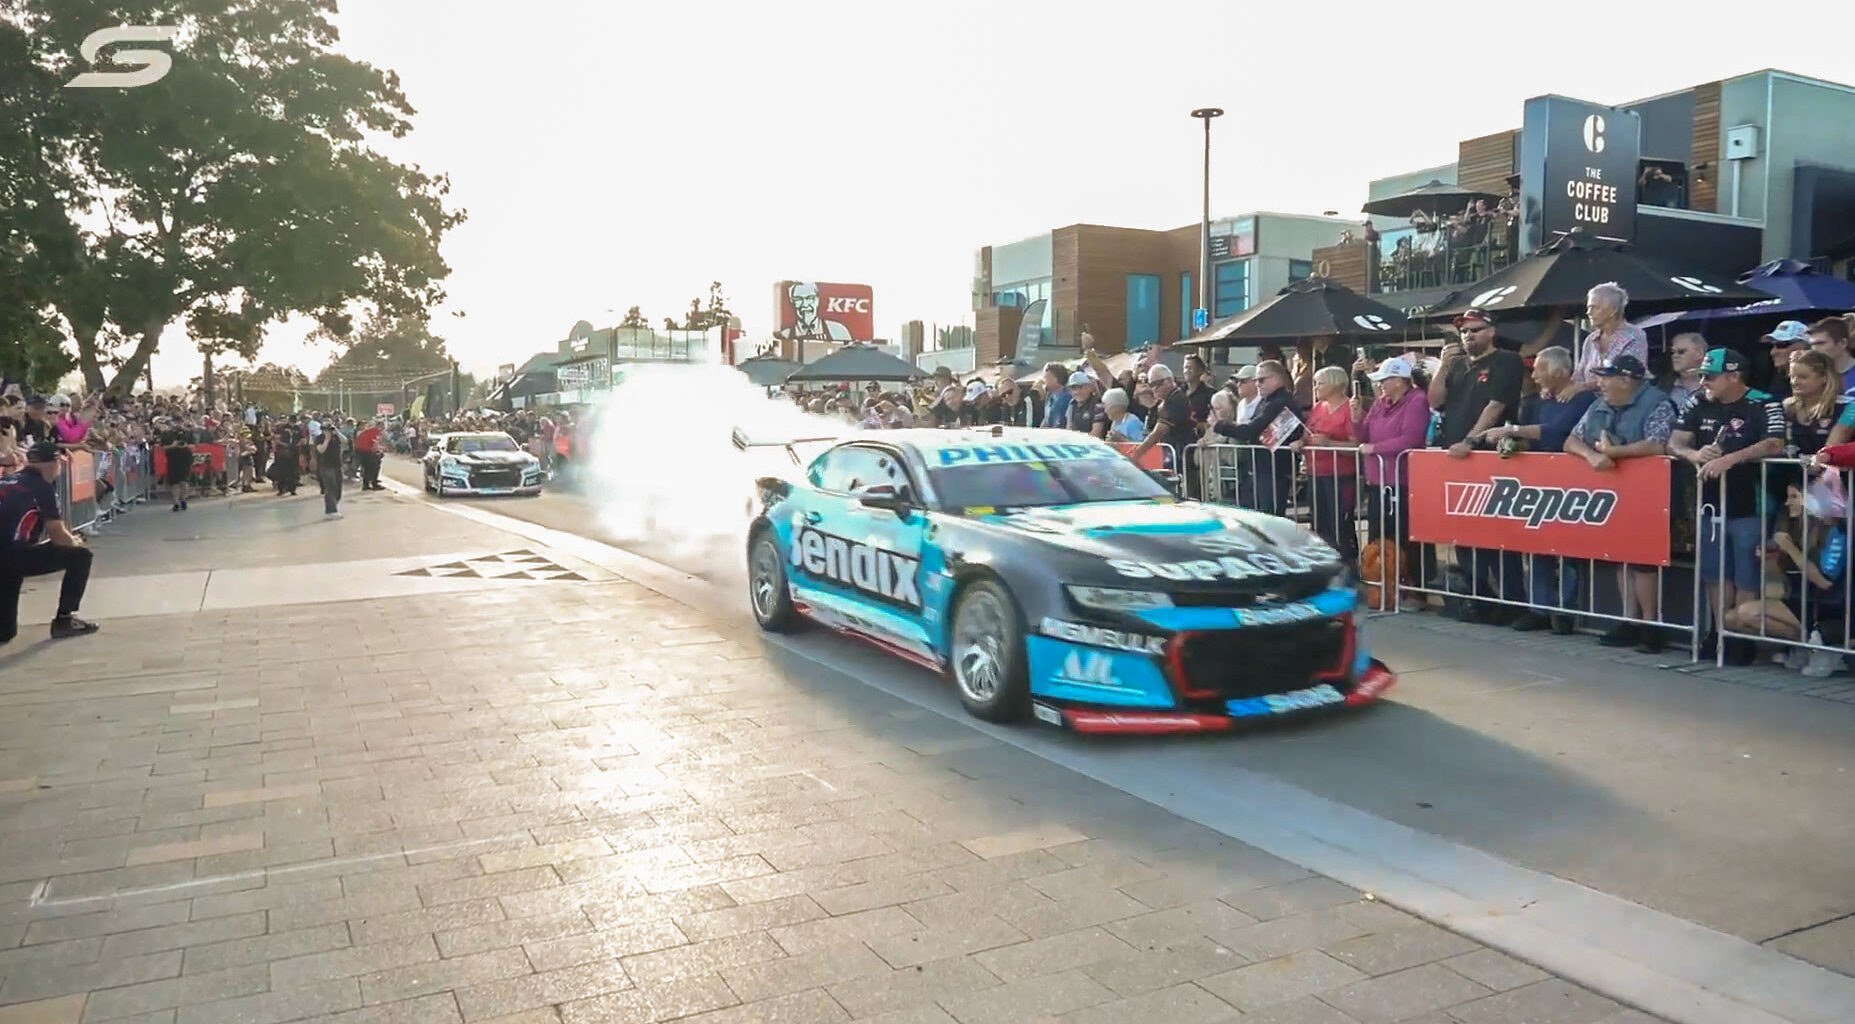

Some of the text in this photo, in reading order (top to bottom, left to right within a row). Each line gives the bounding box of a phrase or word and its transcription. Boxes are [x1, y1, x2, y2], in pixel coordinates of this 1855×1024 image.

[1585, 167, 1602, 179] THE
[1567, 180, 1617, 203] COFFEE
[1575, 203, 1609, 223] CLUB
[826, 297, 869, 313] KFC
[938, 444, 1119, 465] PHILIPS
[1480, 476, 1617, 529] Repco
